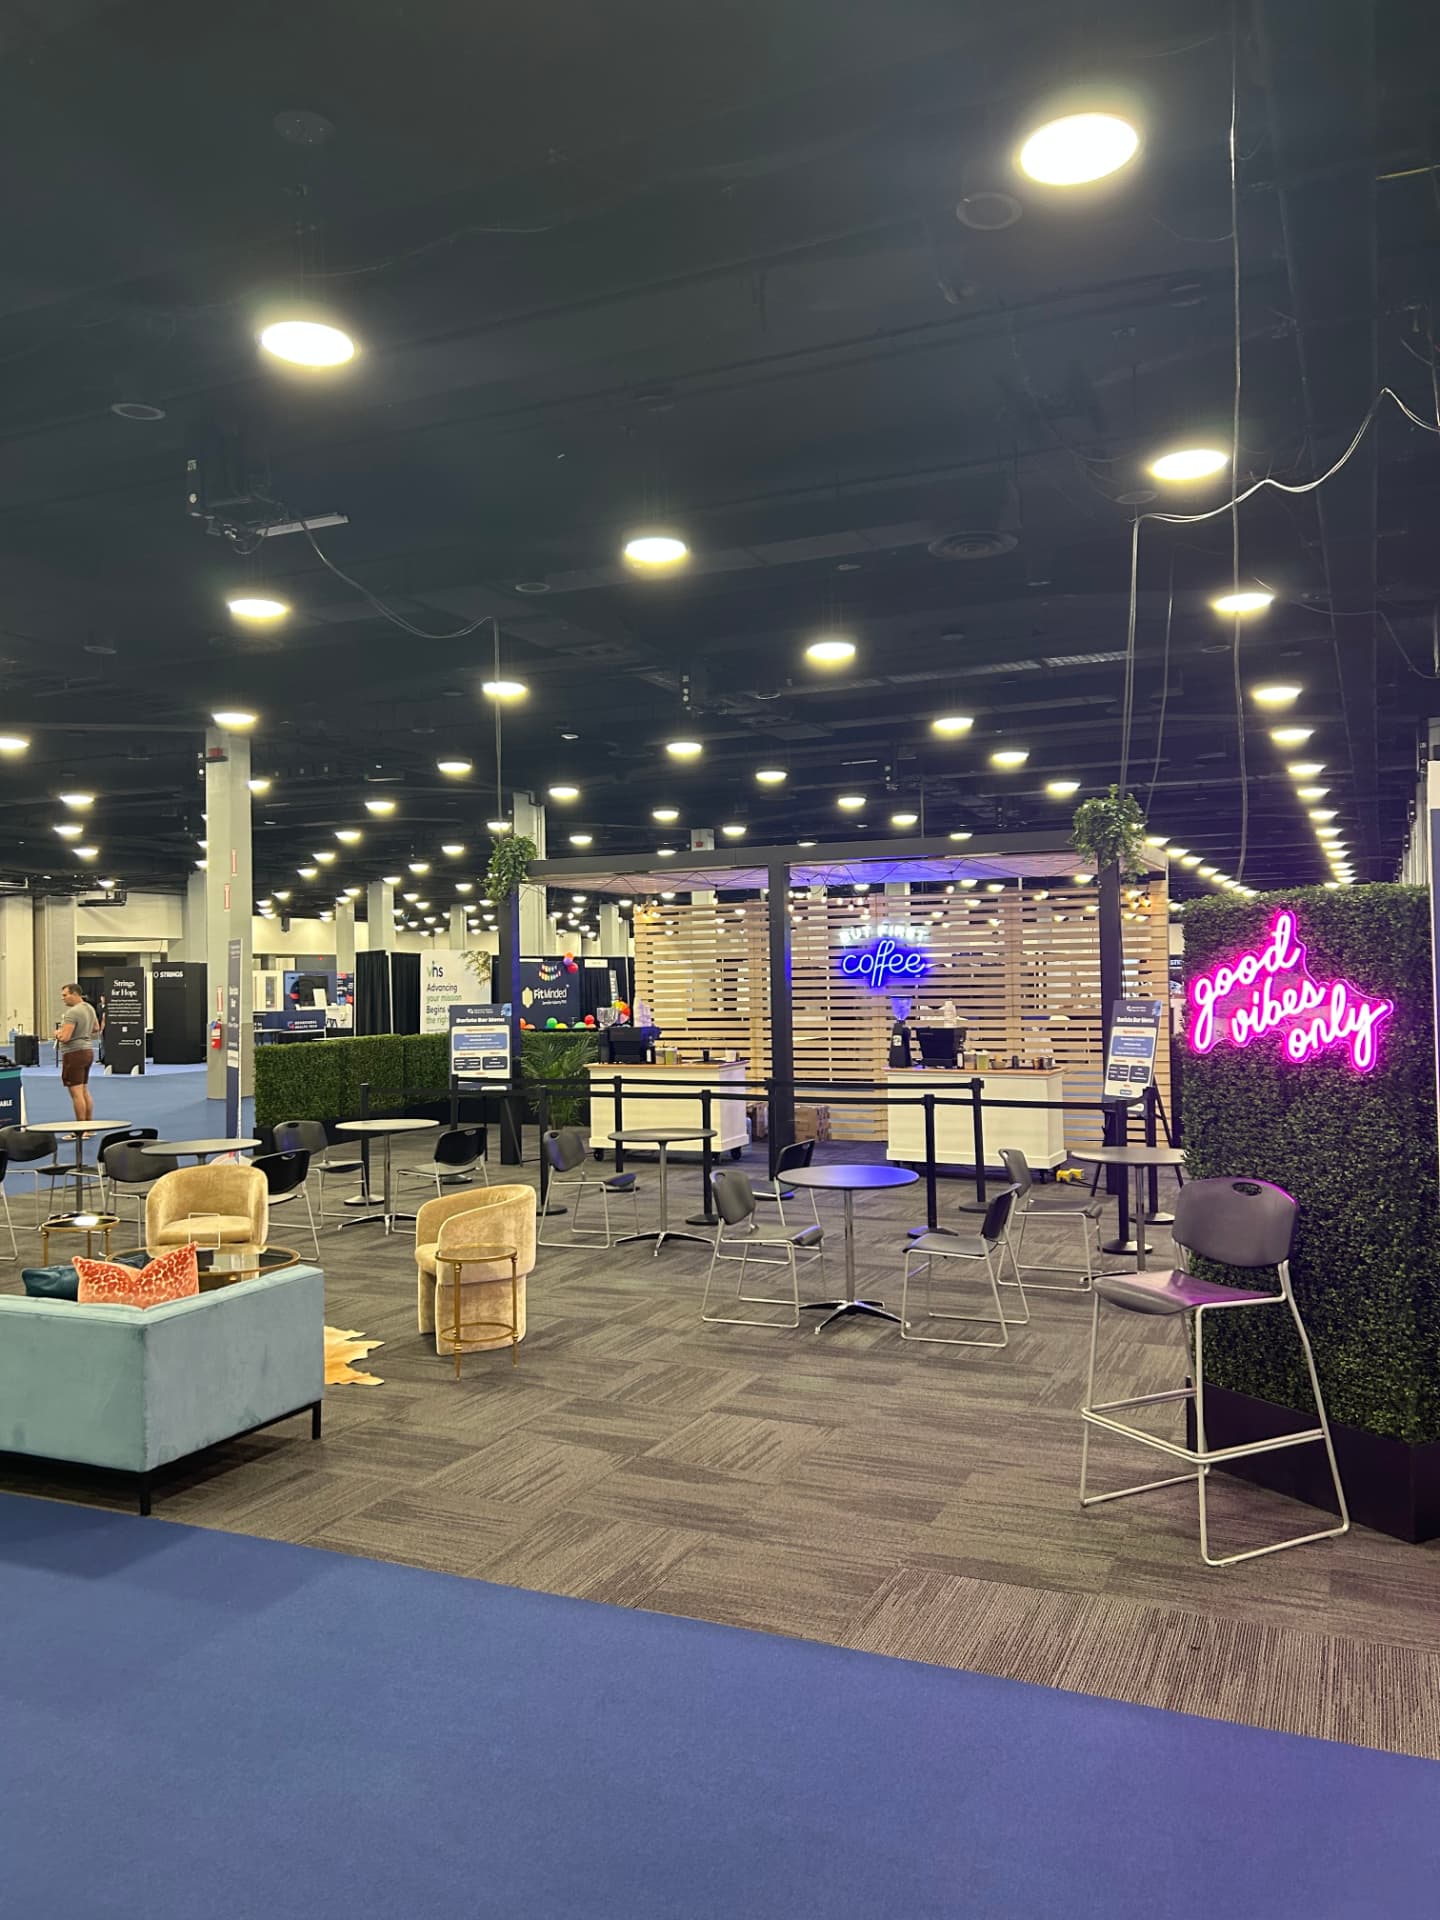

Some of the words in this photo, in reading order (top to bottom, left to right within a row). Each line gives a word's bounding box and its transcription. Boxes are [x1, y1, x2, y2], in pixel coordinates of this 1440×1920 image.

[838, 924, 871, 945] BUT
[842, 939, 927, 987] coffee
[113, 980, 135, 988] Strings
[426, 983, 458, 993] Advancing
[1194, 913, 1302, 1050] good
[533, 987, 568, 1000] FitMinded
[426, 1004, 446, 1016] Begins
[1231, 976, 1327, 1042] vibes
[1286, 983, 1389, 1068] only
